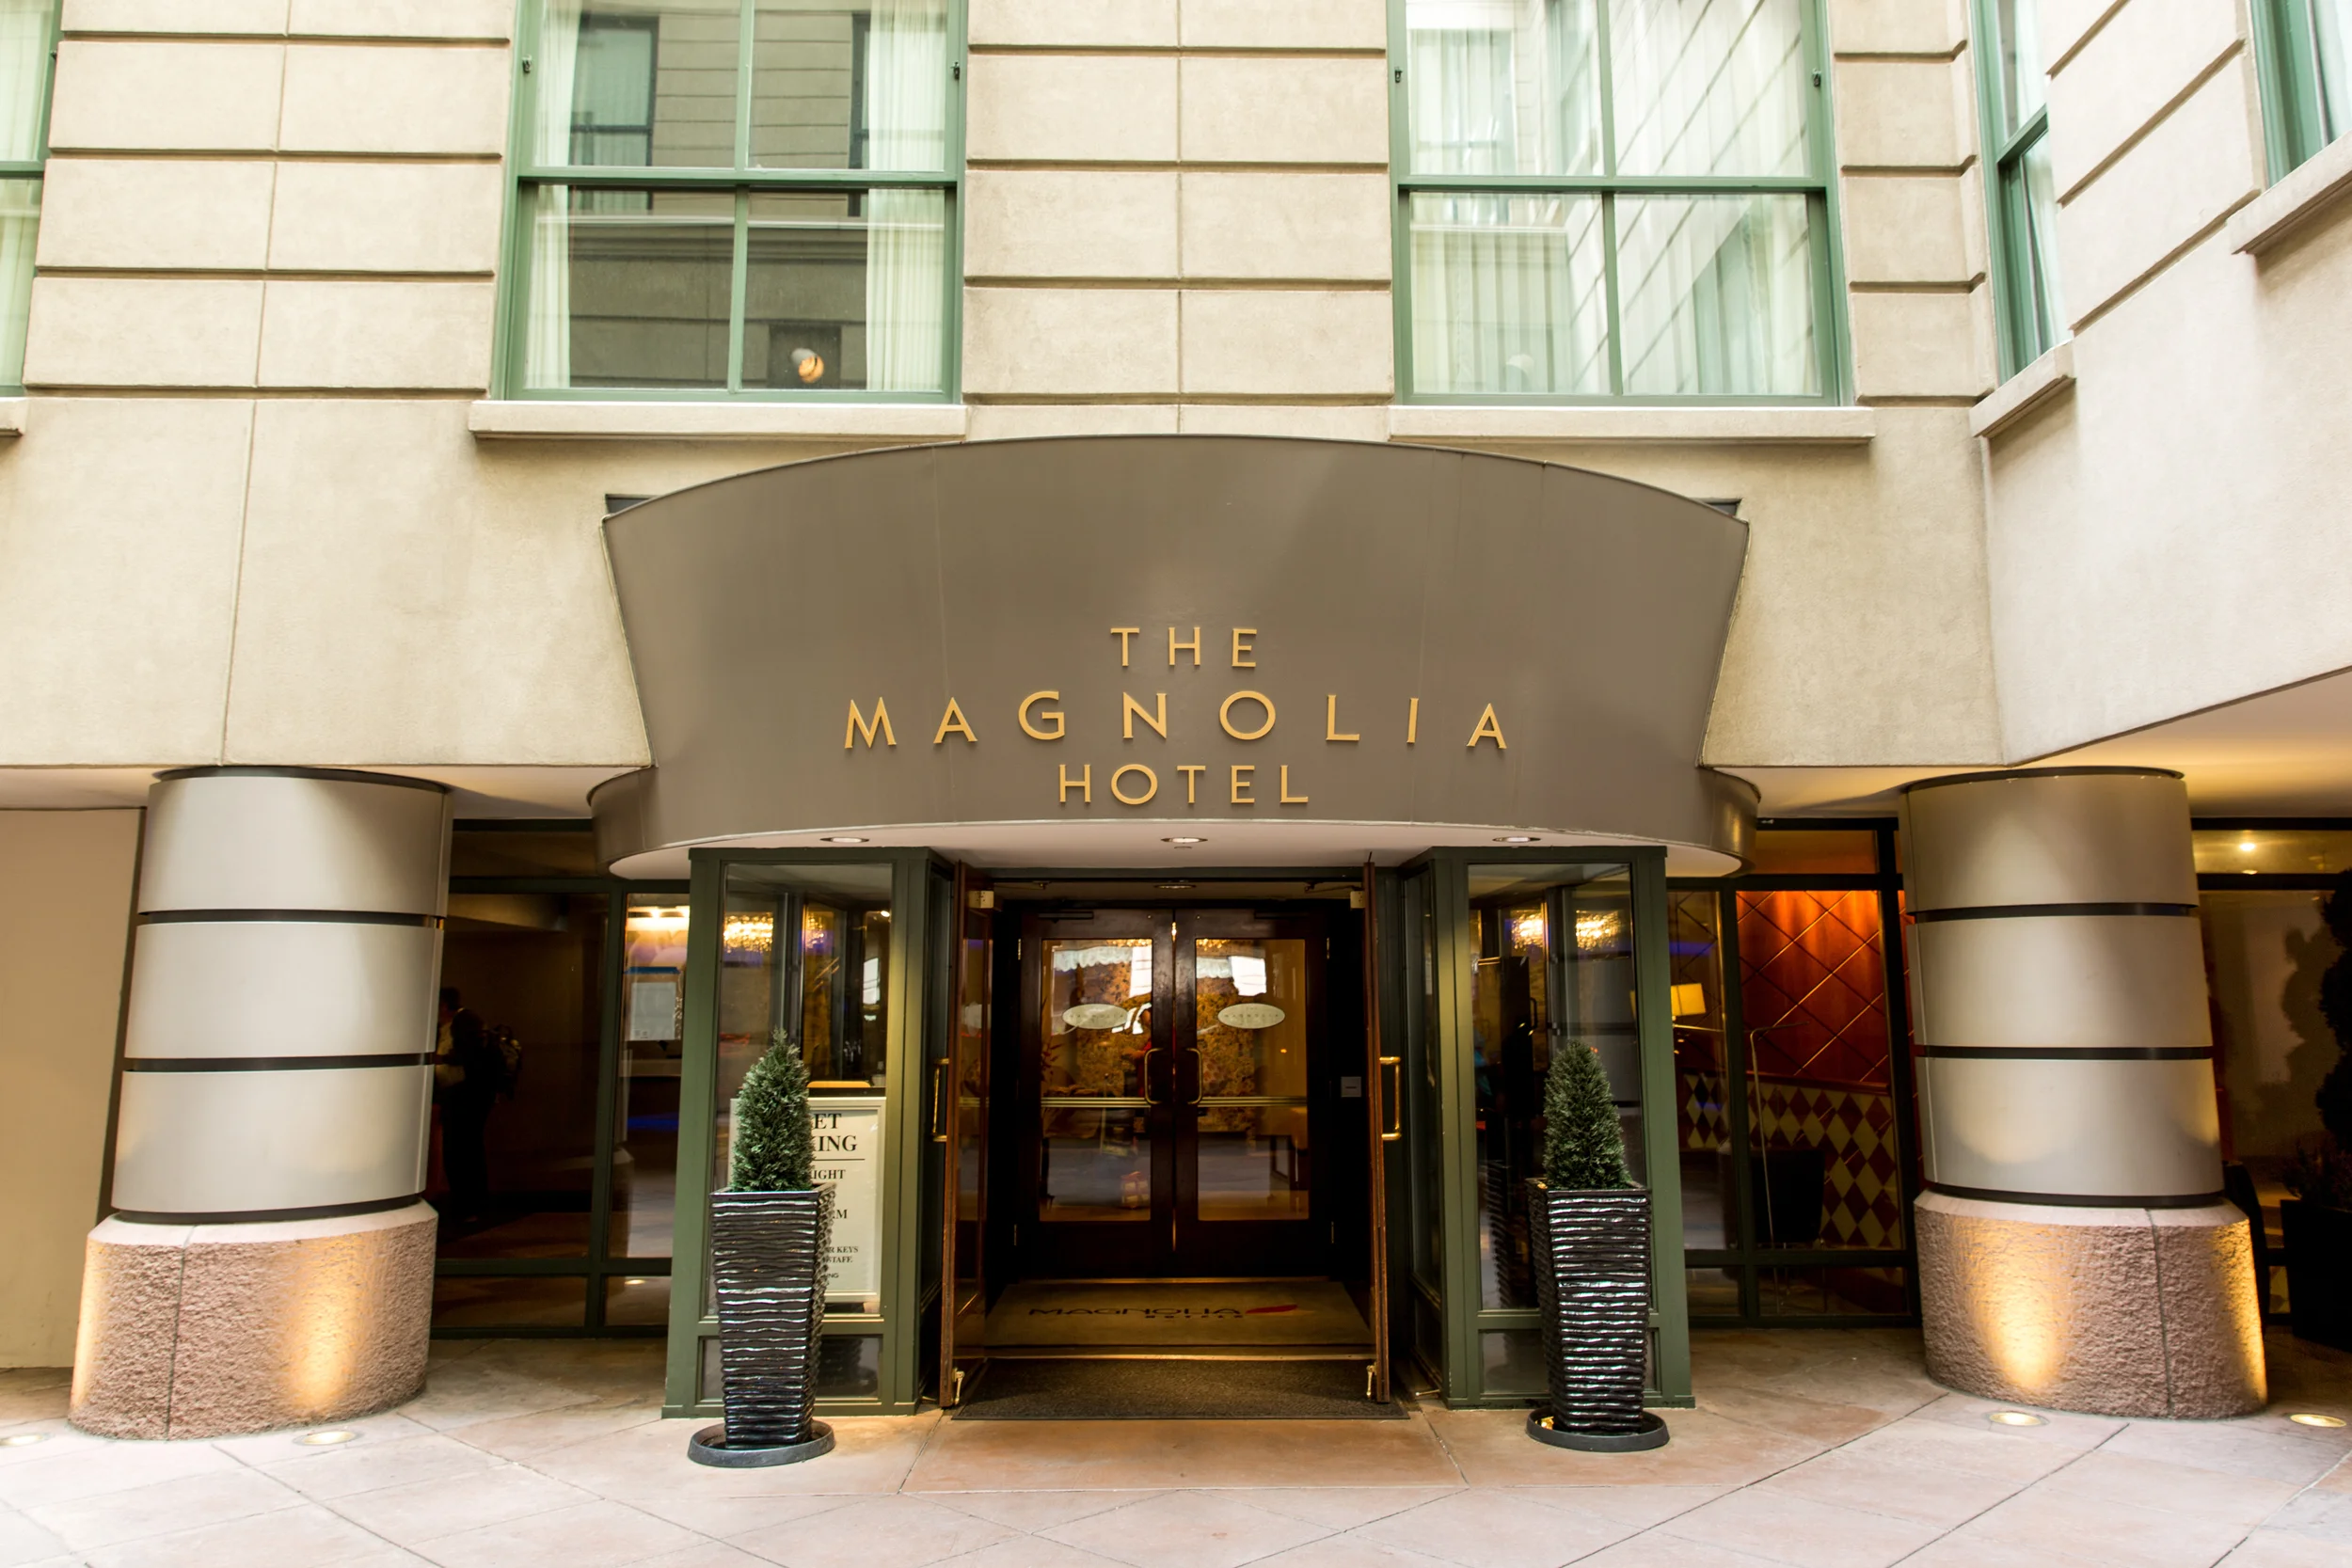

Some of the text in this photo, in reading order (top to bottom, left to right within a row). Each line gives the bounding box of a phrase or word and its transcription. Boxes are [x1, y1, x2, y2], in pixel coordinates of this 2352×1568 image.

[1110, 626, 1258, 668] THE
[845, 690, 1508, 750] MAGNOLIA
[1059, 763, 1309, 805] HOTEL
[836, 1245, 859, 1254] KEYS
[1028, 1307, 1243, 1316] MAGNOLIA
